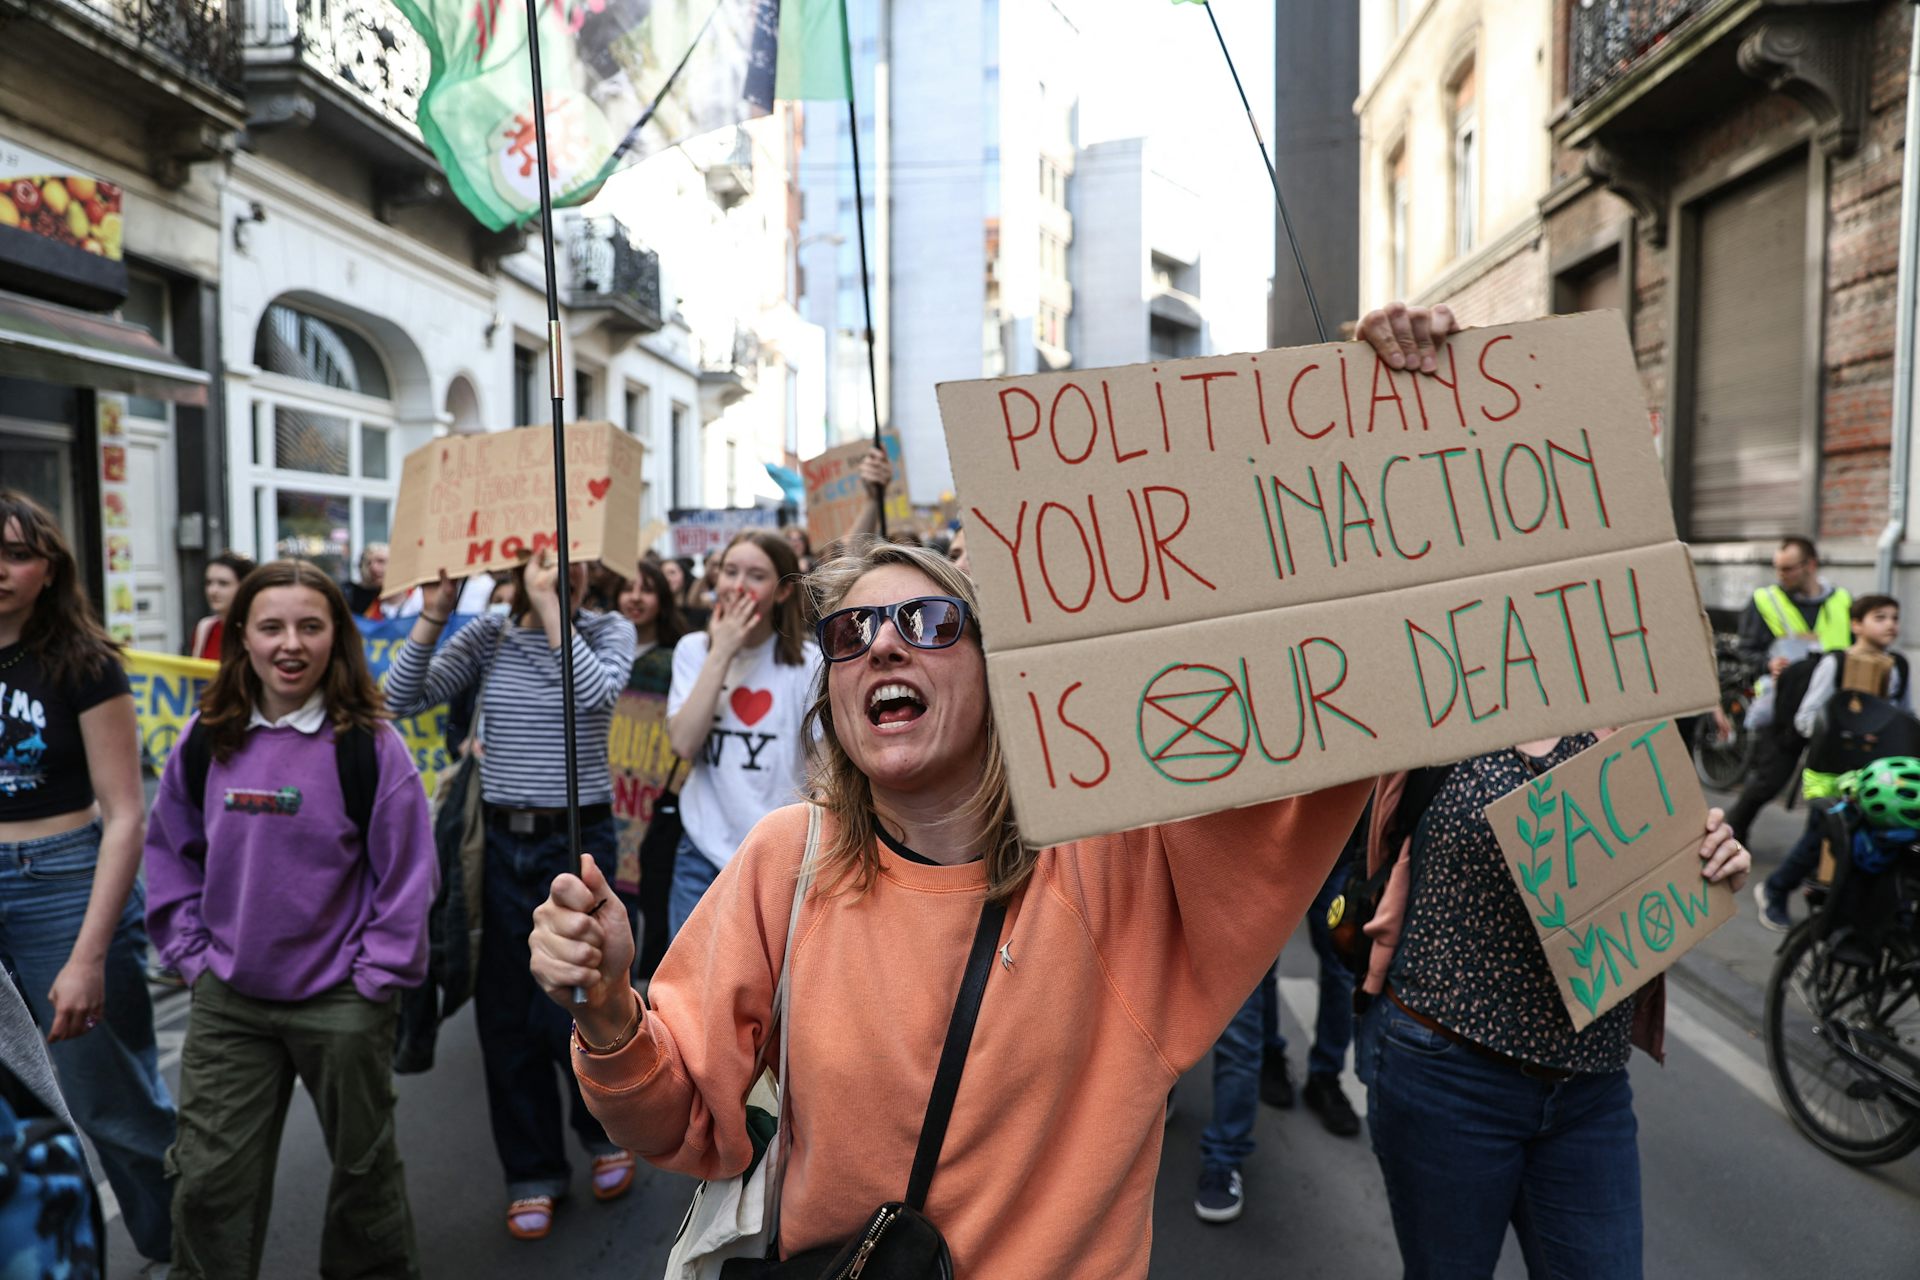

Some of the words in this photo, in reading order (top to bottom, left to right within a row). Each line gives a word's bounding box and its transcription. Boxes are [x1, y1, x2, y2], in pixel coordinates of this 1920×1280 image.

[971, 484, 1217, 624] YOUR
[1136, 636, 1378, 785] OUR
[1405, 566, 1660, 728] DEATH
[1560, 720, 1676, 889] ACT
[1595, 862, 1710, 988] NOW
